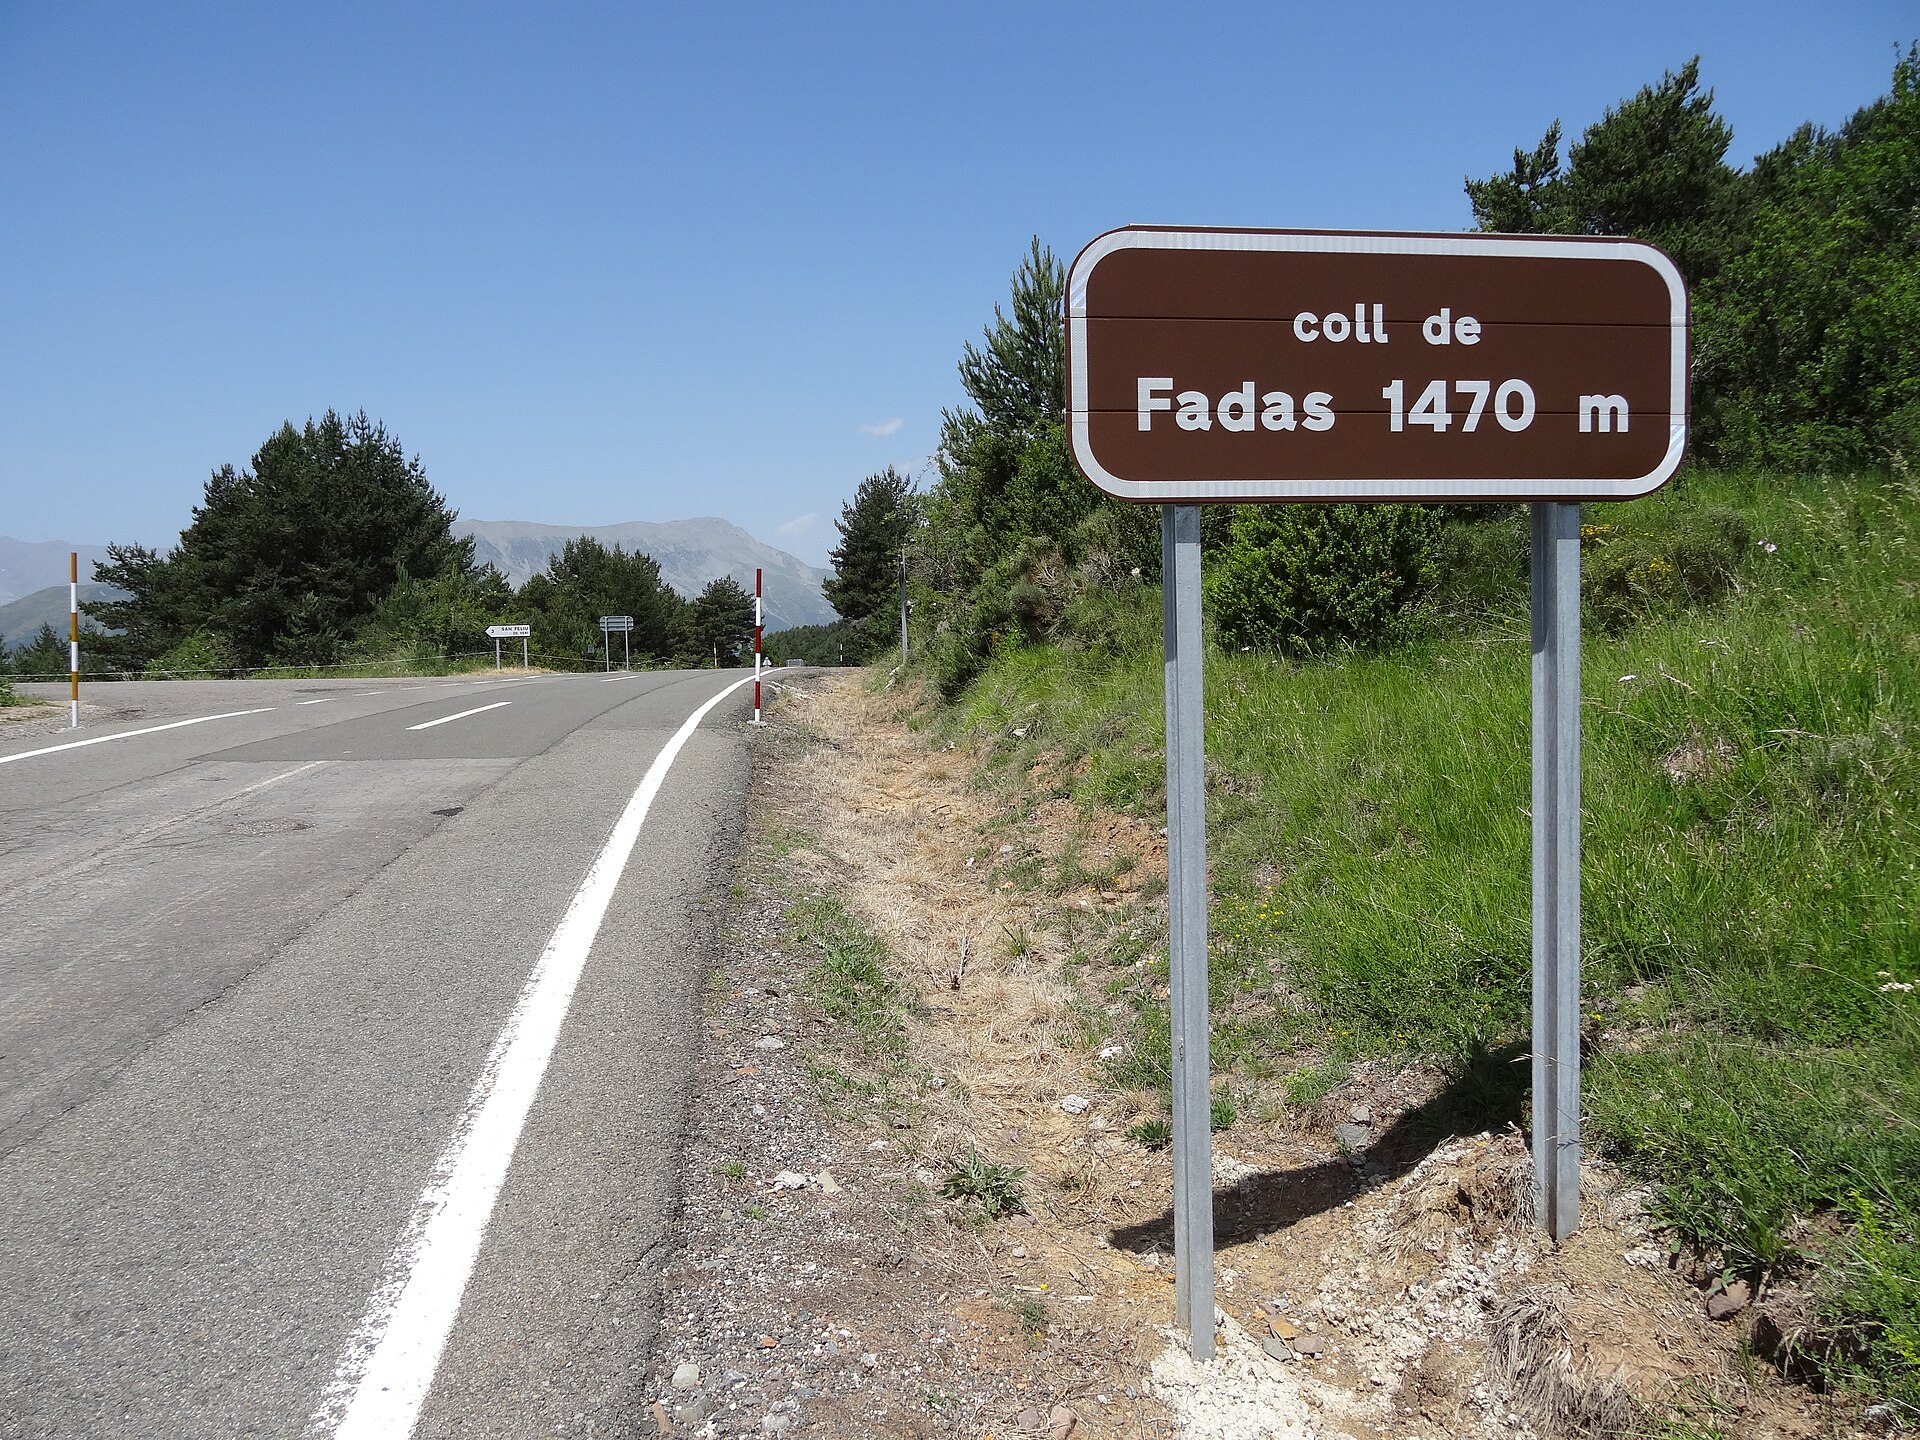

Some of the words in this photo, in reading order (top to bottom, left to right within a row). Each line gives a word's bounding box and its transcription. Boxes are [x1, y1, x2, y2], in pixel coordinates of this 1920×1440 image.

[1293, 303, 1389, 344] coll
[1422, 307, 1482, 346] de
[1137, 377, 1336, 433] Fadas
[1382, 379, 1536, 433] 1470
[1578, 394, 1630, 433] m
